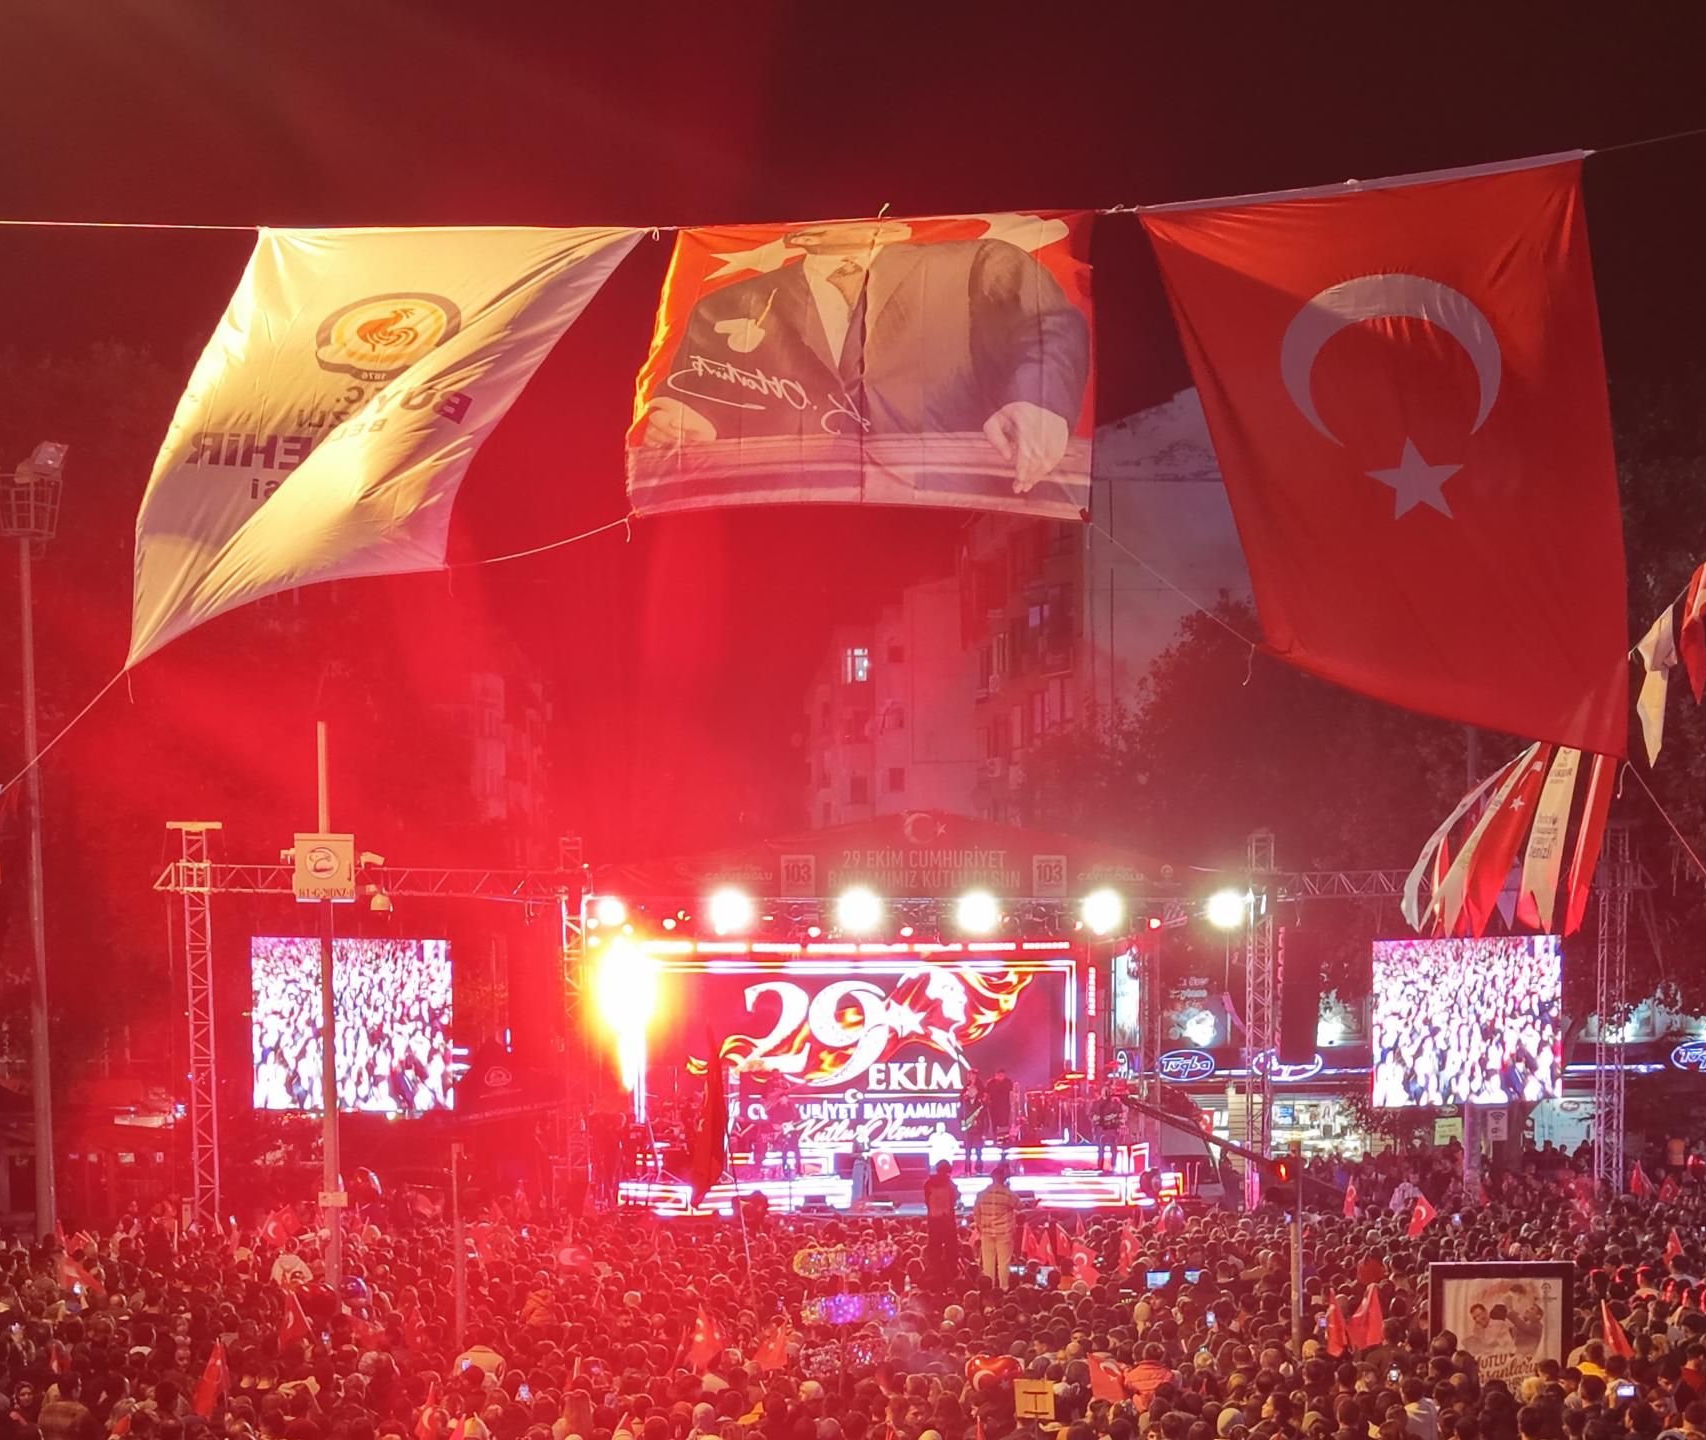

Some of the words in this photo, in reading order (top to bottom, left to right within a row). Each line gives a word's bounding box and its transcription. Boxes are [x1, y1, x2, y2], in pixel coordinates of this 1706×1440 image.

[842, 852, 863, 869] 29
[866, 848, 904, 869] EKİM
[908, 847, 1007, 869] CUMHURİYET
[783, 863, 812, 882] 103
[1036, 863, 1063, 882] 103
[734, 979, 890, 1087] 29
[866, 1055, 964, 1090] EKİM
